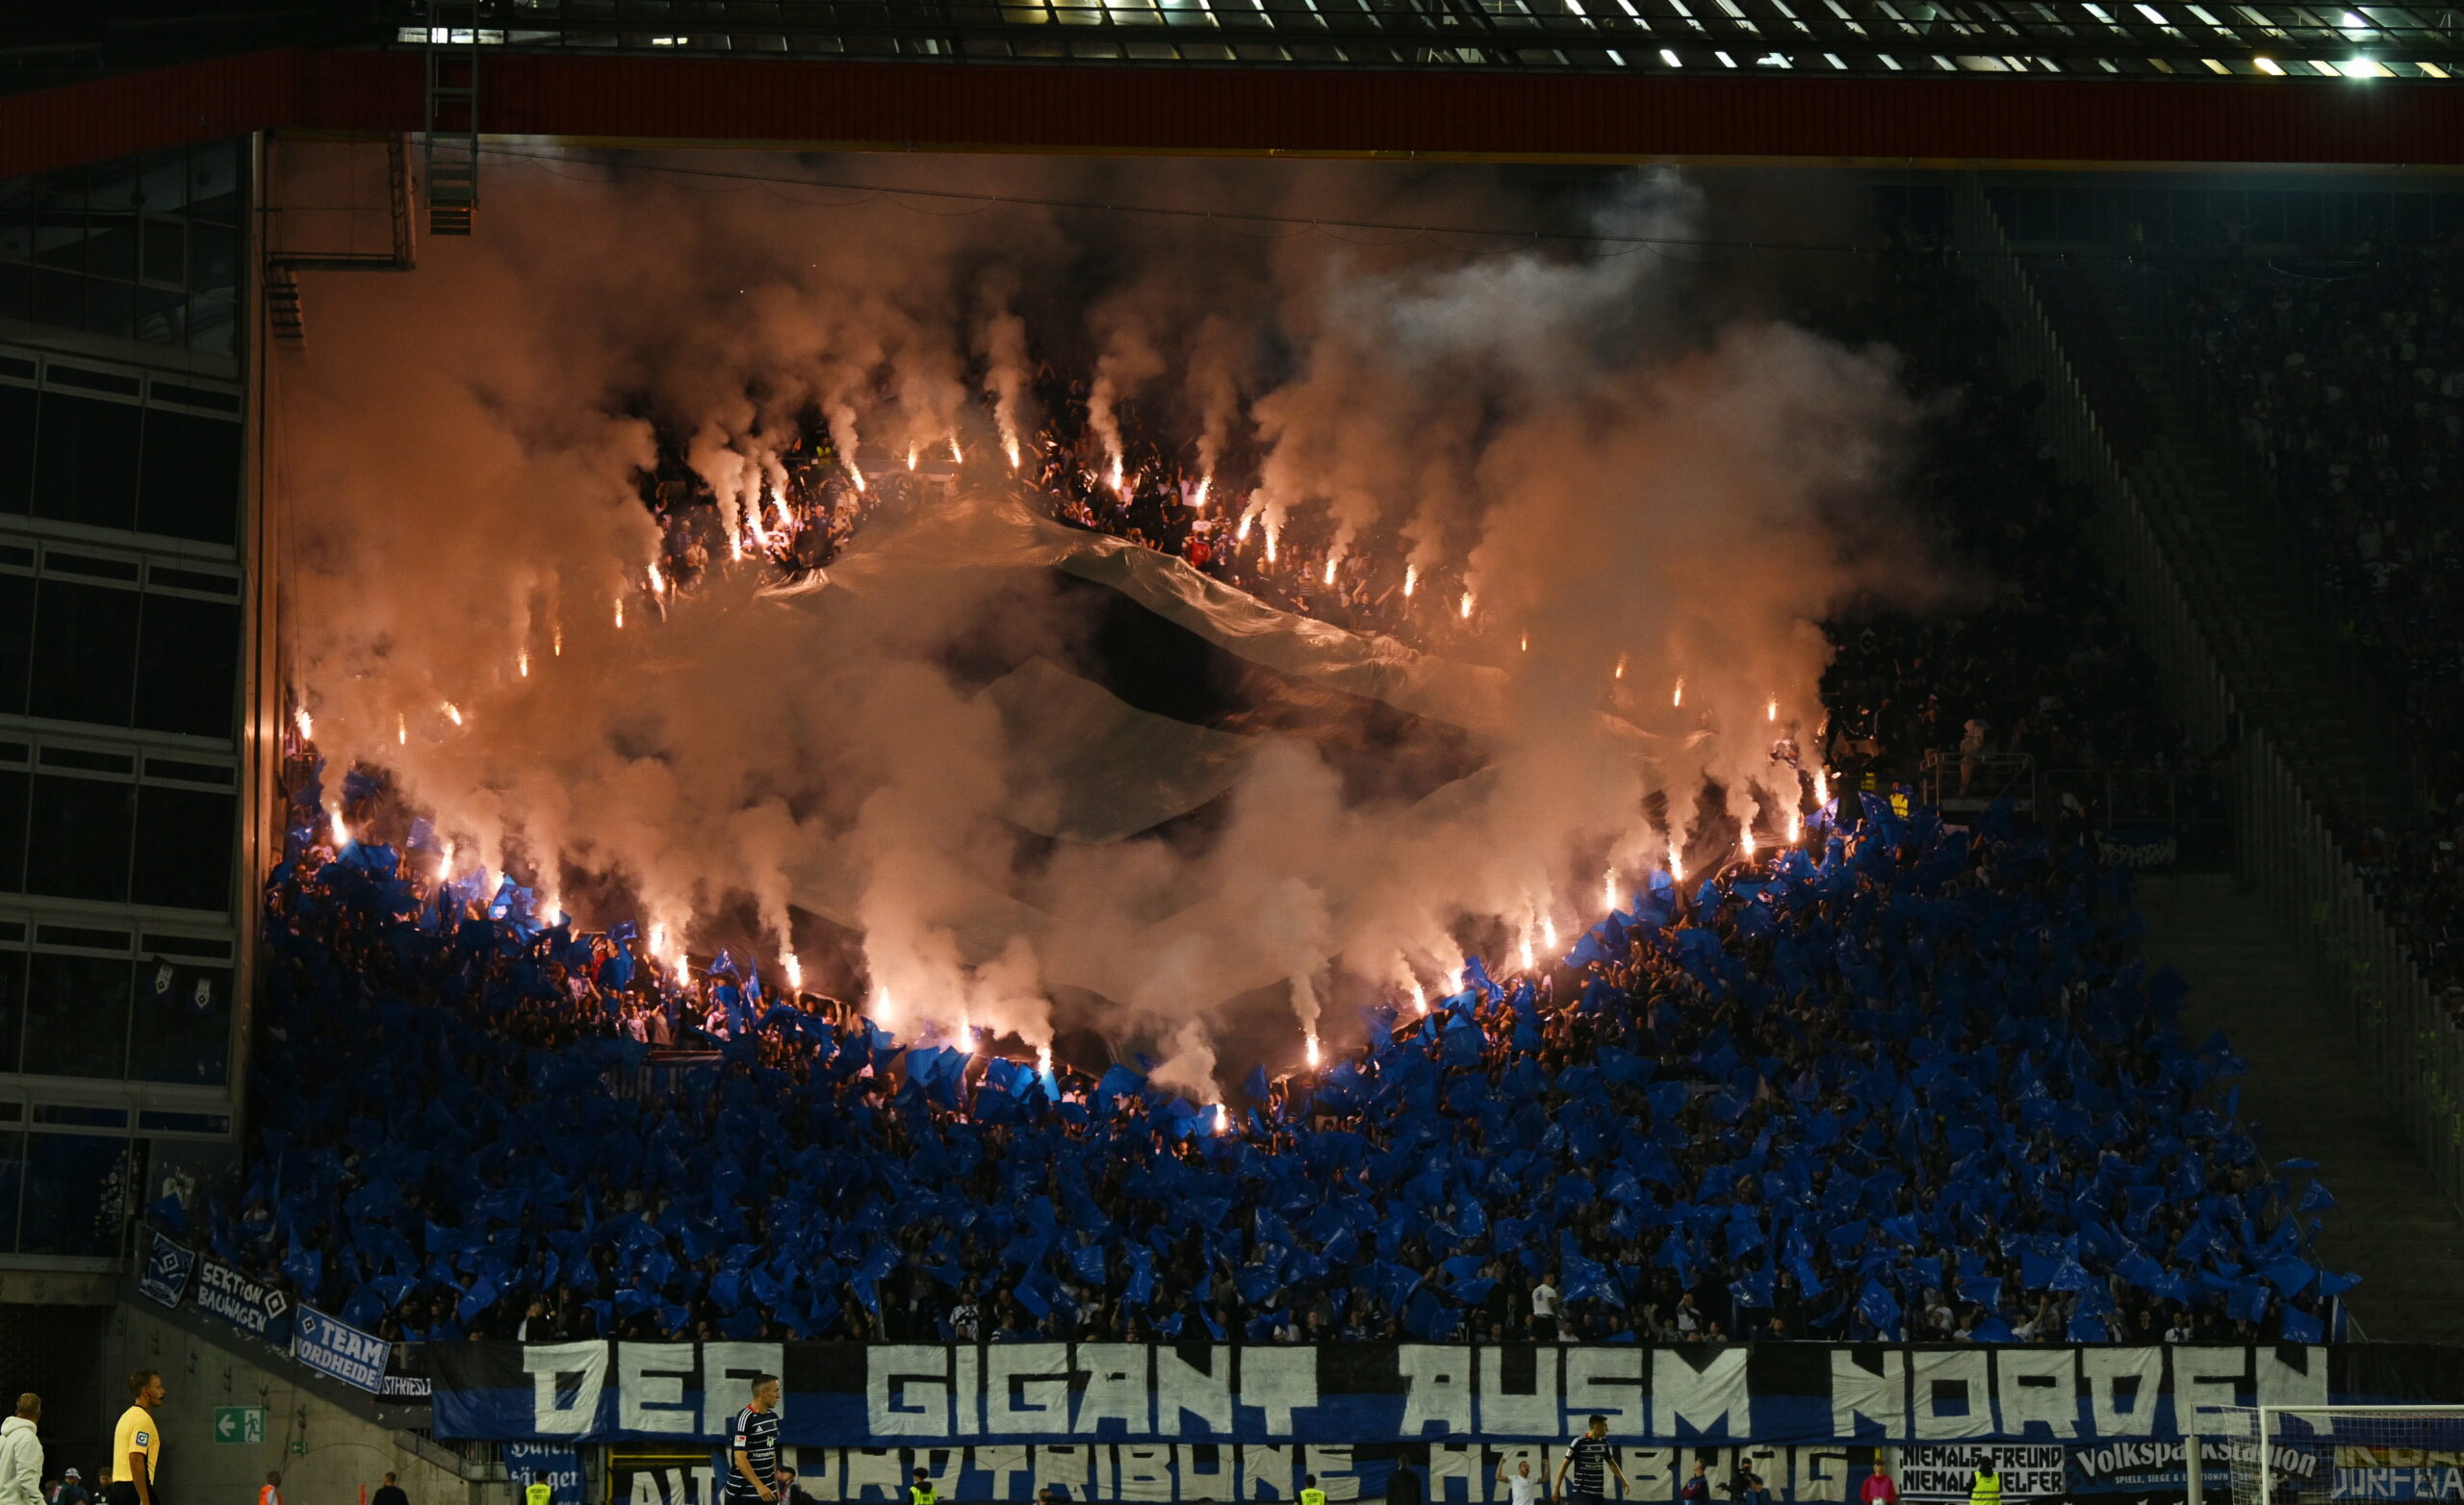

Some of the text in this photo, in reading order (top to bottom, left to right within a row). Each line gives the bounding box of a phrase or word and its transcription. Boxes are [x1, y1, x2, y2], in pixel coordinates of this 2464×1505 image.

[197, 1285, 269, 1334] BAUWAGEN
[321, 1319, 384, 1367] TEAM
[524, 1340, 2333, 1440] DER GIGANT AUSM NORDEN
[1903, 1445, 2063, 1468] NIEMALS FREUND
[2075, 1441, 2317, 1478] Volkspakstaion
[1903, 1470, 2063, 1492] NIEMAL ELFER
[2116, 1475, 2145, 1485] SPIELE,
[2148, 1473, 2170, 1483] SIEGE
[2173, 1473, 2179, 1482] &
